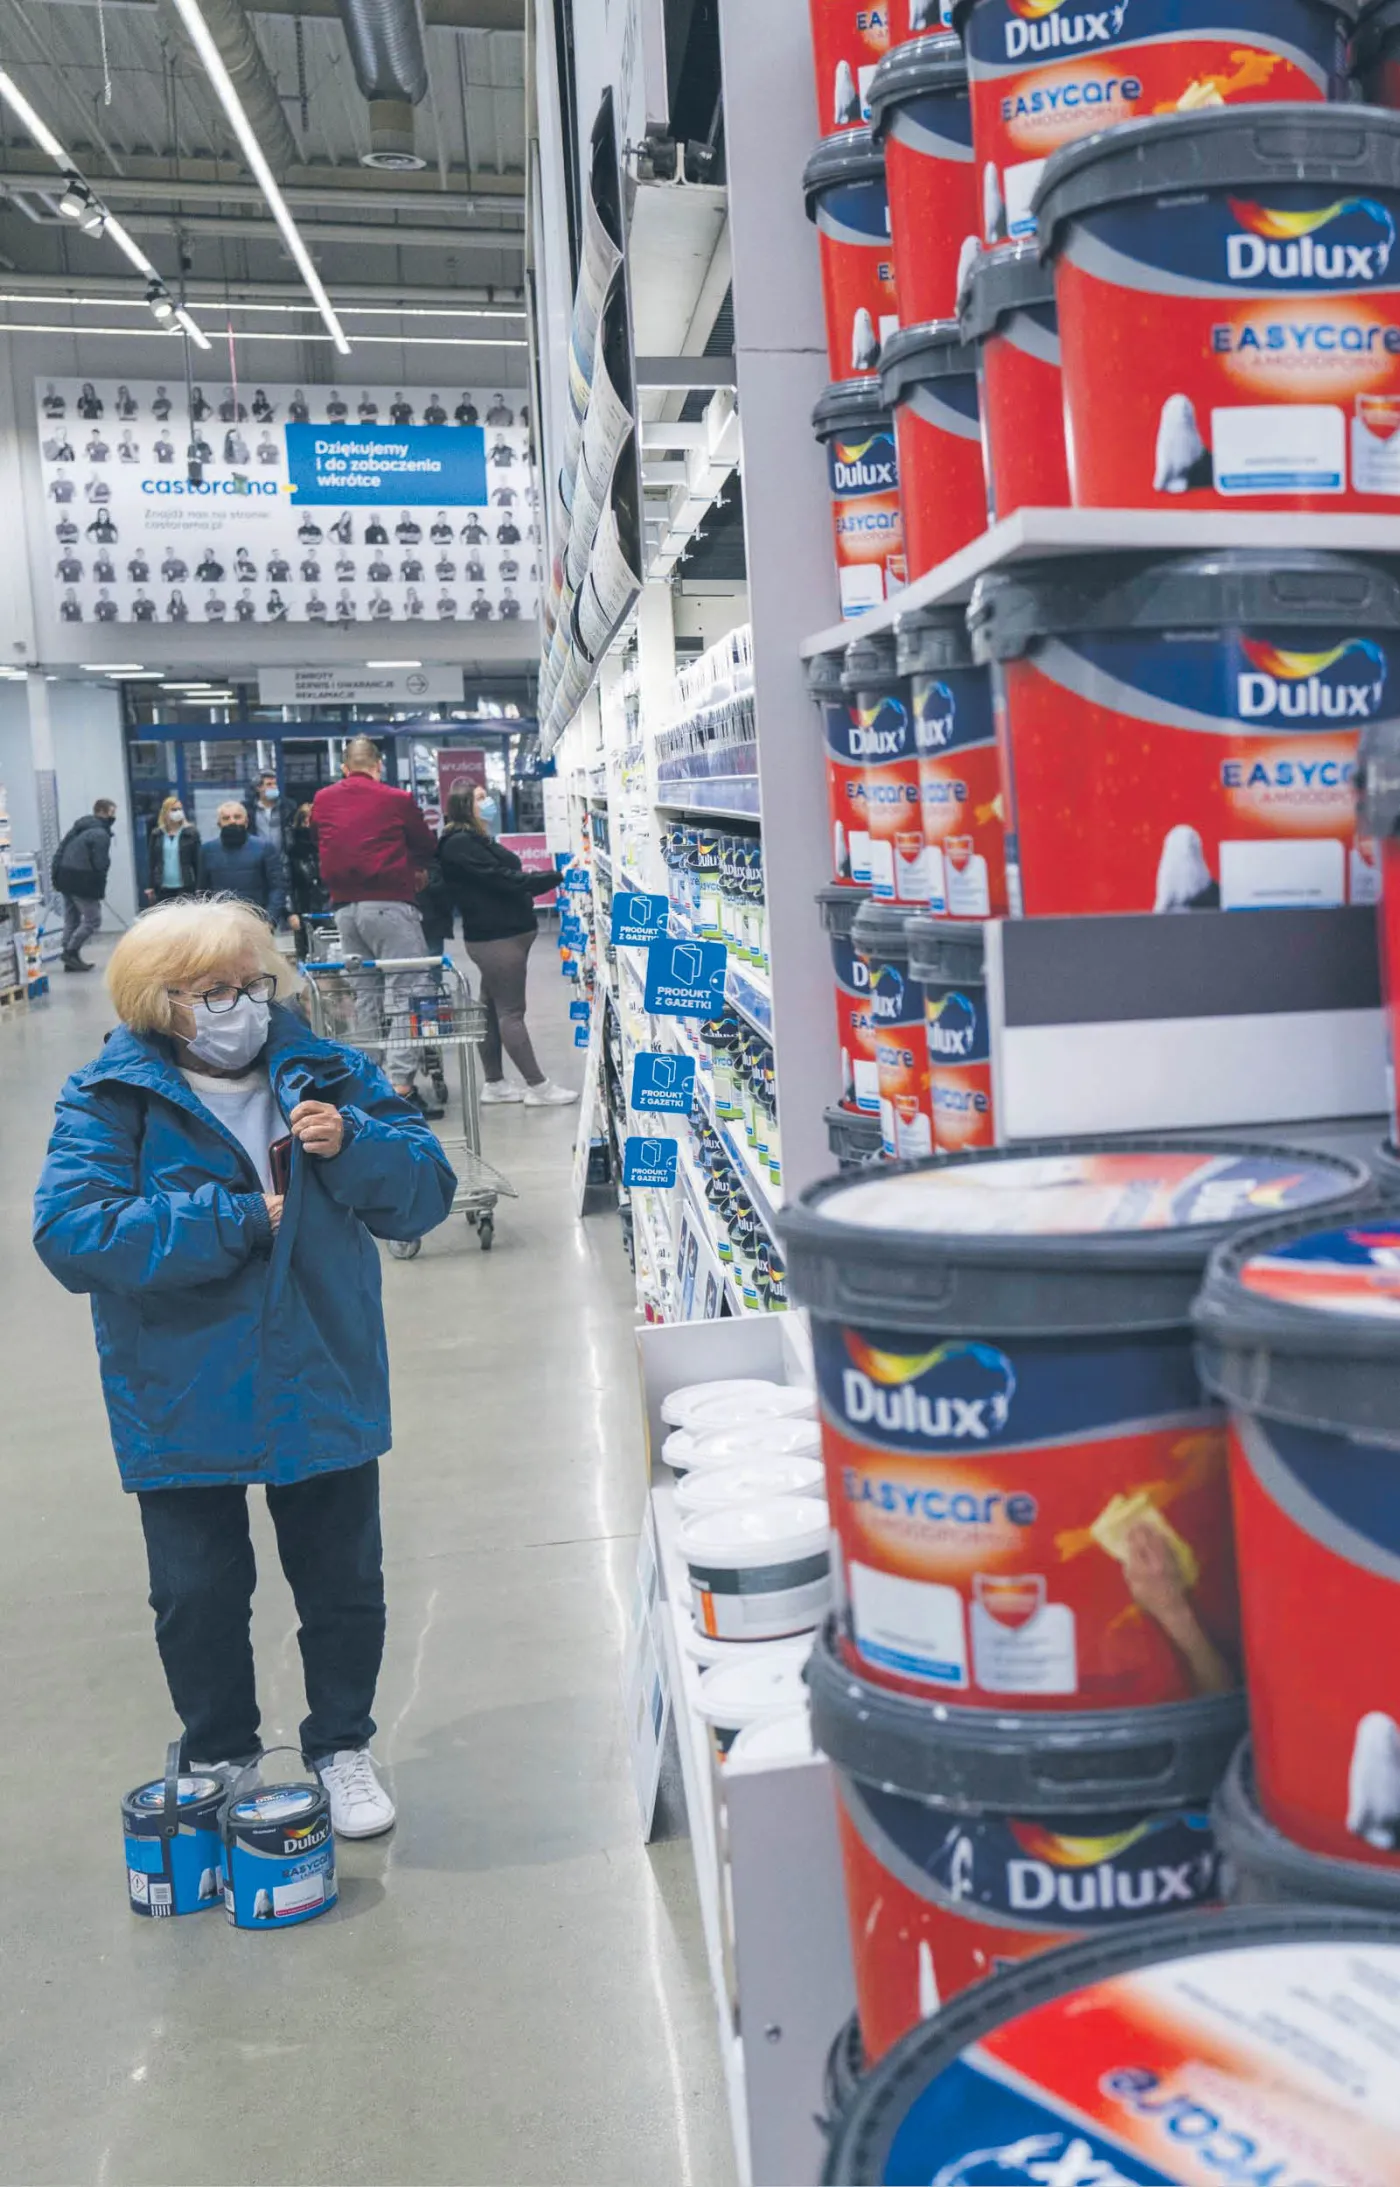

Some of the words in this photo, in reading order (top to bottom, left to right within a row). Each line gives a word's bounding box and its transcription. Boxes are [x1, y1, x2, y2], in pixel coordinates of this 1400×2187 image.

[1004, 12, 1110, 59] Dulux
[1226, 233, 1374, 280] Dulux
[314, 440, 409, 458] Dziękujemy
[325, 458, 346, 471] do
[350, 458, 441, 472] zobaczenia
[317, 472, 381, 488] wkrótce
[834, 461, 893, 489] Dulux
[1237, 672, 1370, 718] Dulux
[620, 926, 659, 935] PRODUKT
[657, 986, 712, 999] PRODUKT
[655, 996, 663, 1006] Z
[664, 998, 712, 1010] GAZETKI
[640, 1097, 645, 1105] Z
[647, 1097, 684, 1107] GAZETKI
[641, 1089, 684, 1099] PRODUKT
[631, 1167, 668, 1176] PRODUKT
[637, 1175, 668, 1183] GAZETKI
[843, 1367, 990, 1440] Dulux
[284, 1831, 327, 1854] Dulux
[1007, 1858, 1192, 1911] Dulux
